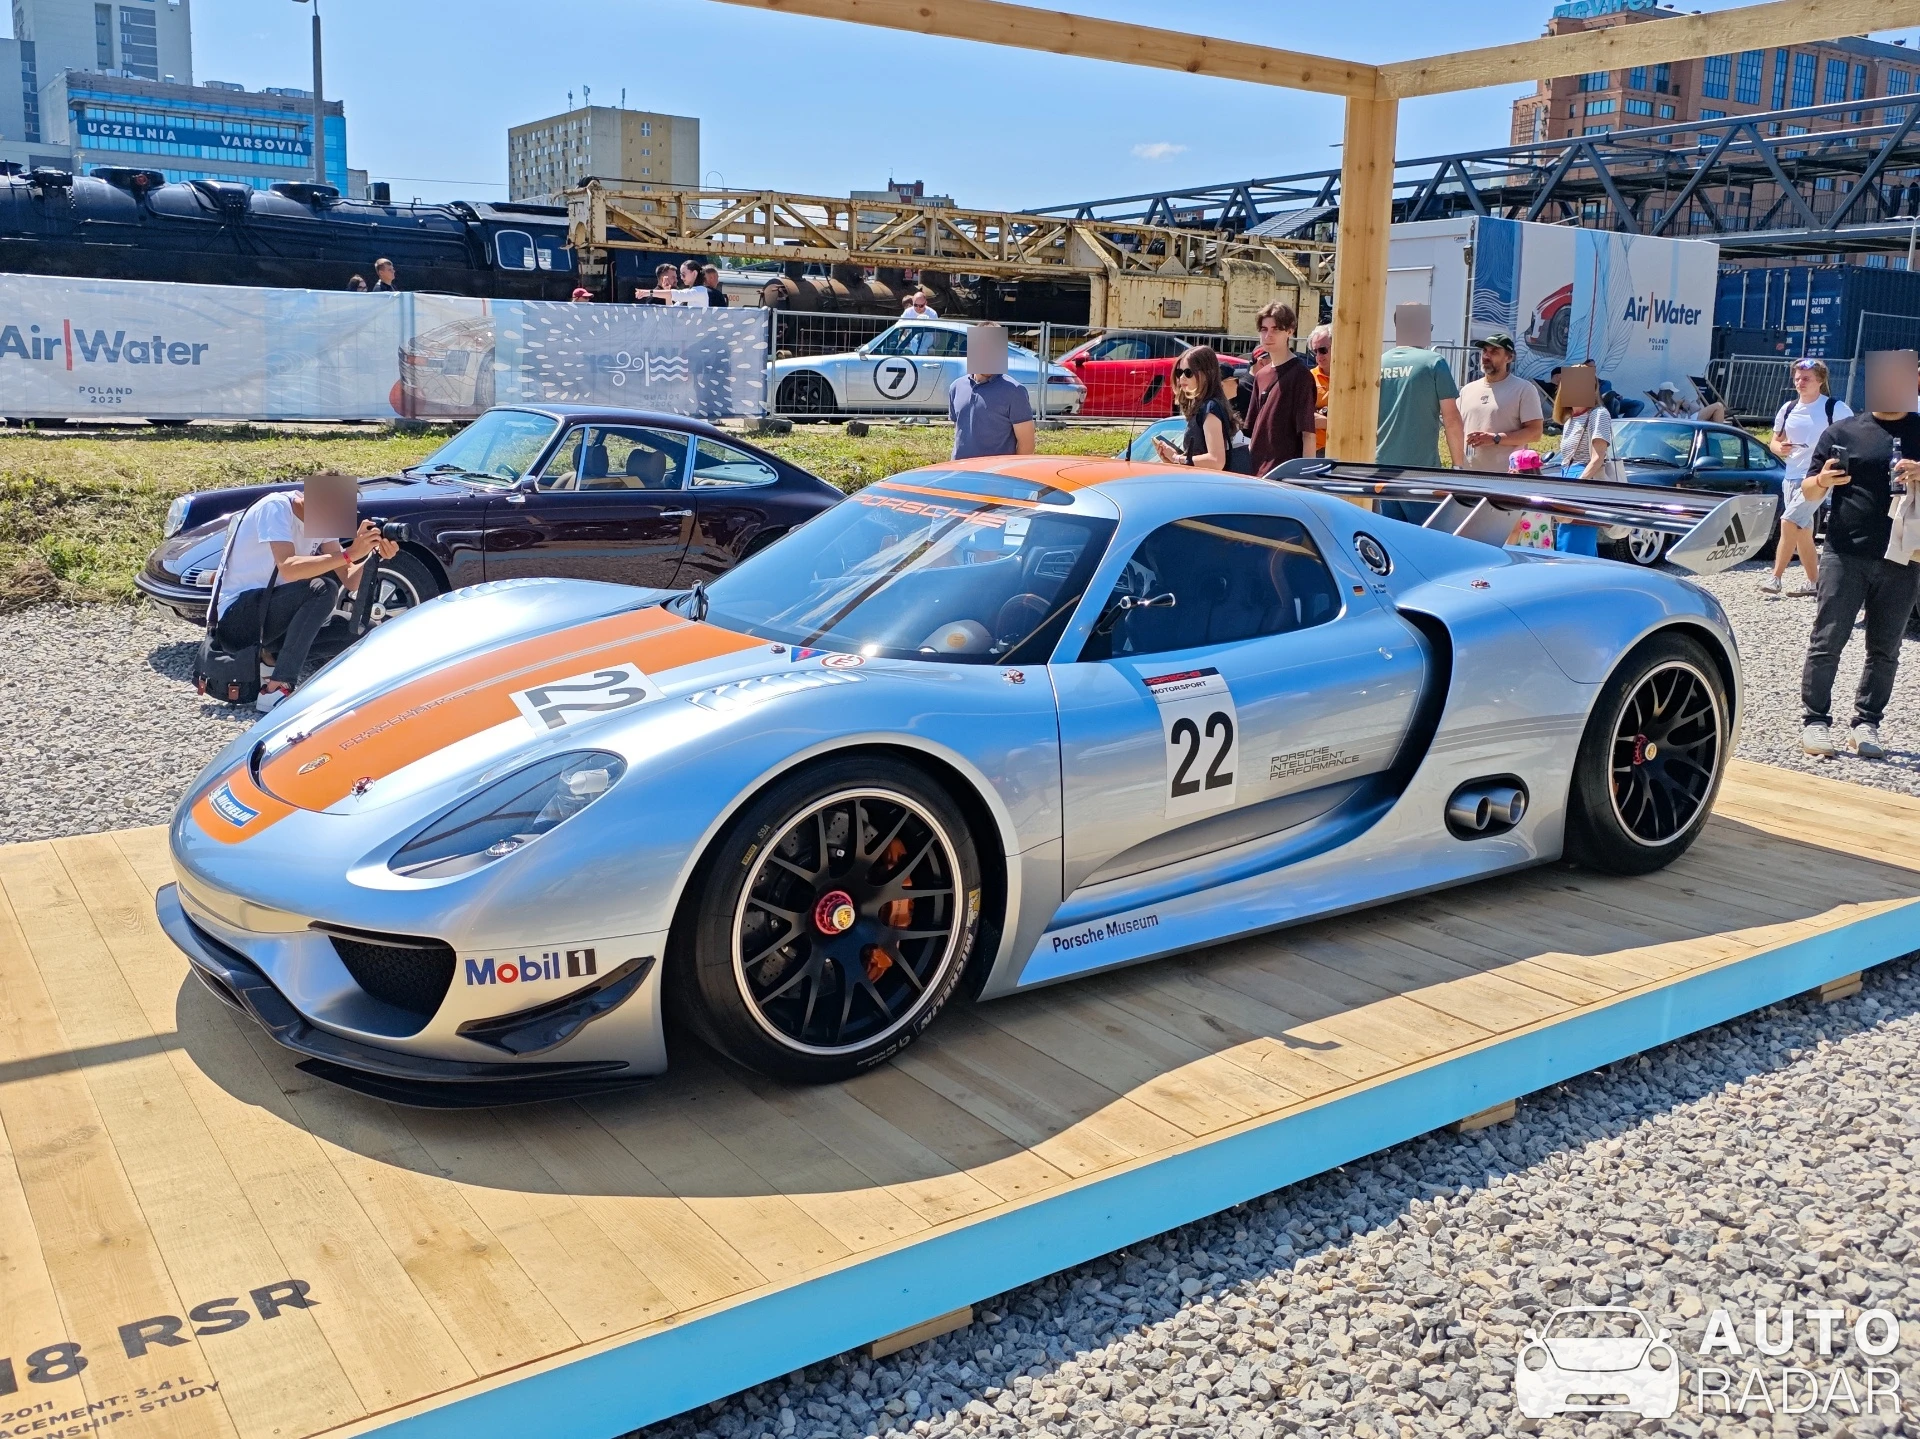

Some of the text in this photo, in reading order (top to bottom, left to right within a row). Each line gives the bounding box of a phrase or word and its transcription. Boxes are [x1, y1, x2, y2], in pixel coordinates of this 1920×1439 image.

[87, 122, 304, 153] UCZELNIA VARSOVIA
[78, 386, 133, 395] POLAND
[886, 366, 907, 389] 7
[90, 395, 123, 404] 2025
[851, 493, 1008, 528] PORSCHE
[1705, 543, 1750, 561] adidas
[1145, 670, 1202, 684] PORSCHE
[1150, 681, 1207, 695] MOTORSPORT
[524, 670, 646, 730] 22
[1171, 711, 1234, 798] 22
[1269, 755, 1360, 780] PERFORMANCE
[1270, 750, 1345, 772] INTELLIGENT
[1271, 746, 1330, 764] PORSCHE
[216, 793, 255, 822] MICHELIN
[757, 824, 771, 839] S9A
[1052, 914, 1159, 953] Porsche Museum
[464, 952, 561, 985] Mobil
[920, 932, 974, 1030] MICHELIN
[118, 1278, 322, 1360] RSR
[0, 1376, 194, 1439] ACEMENT: 3.4 L
[139, 1380, 220, 1413] STUDY
[1, 1400, 54, 1424] 2011
